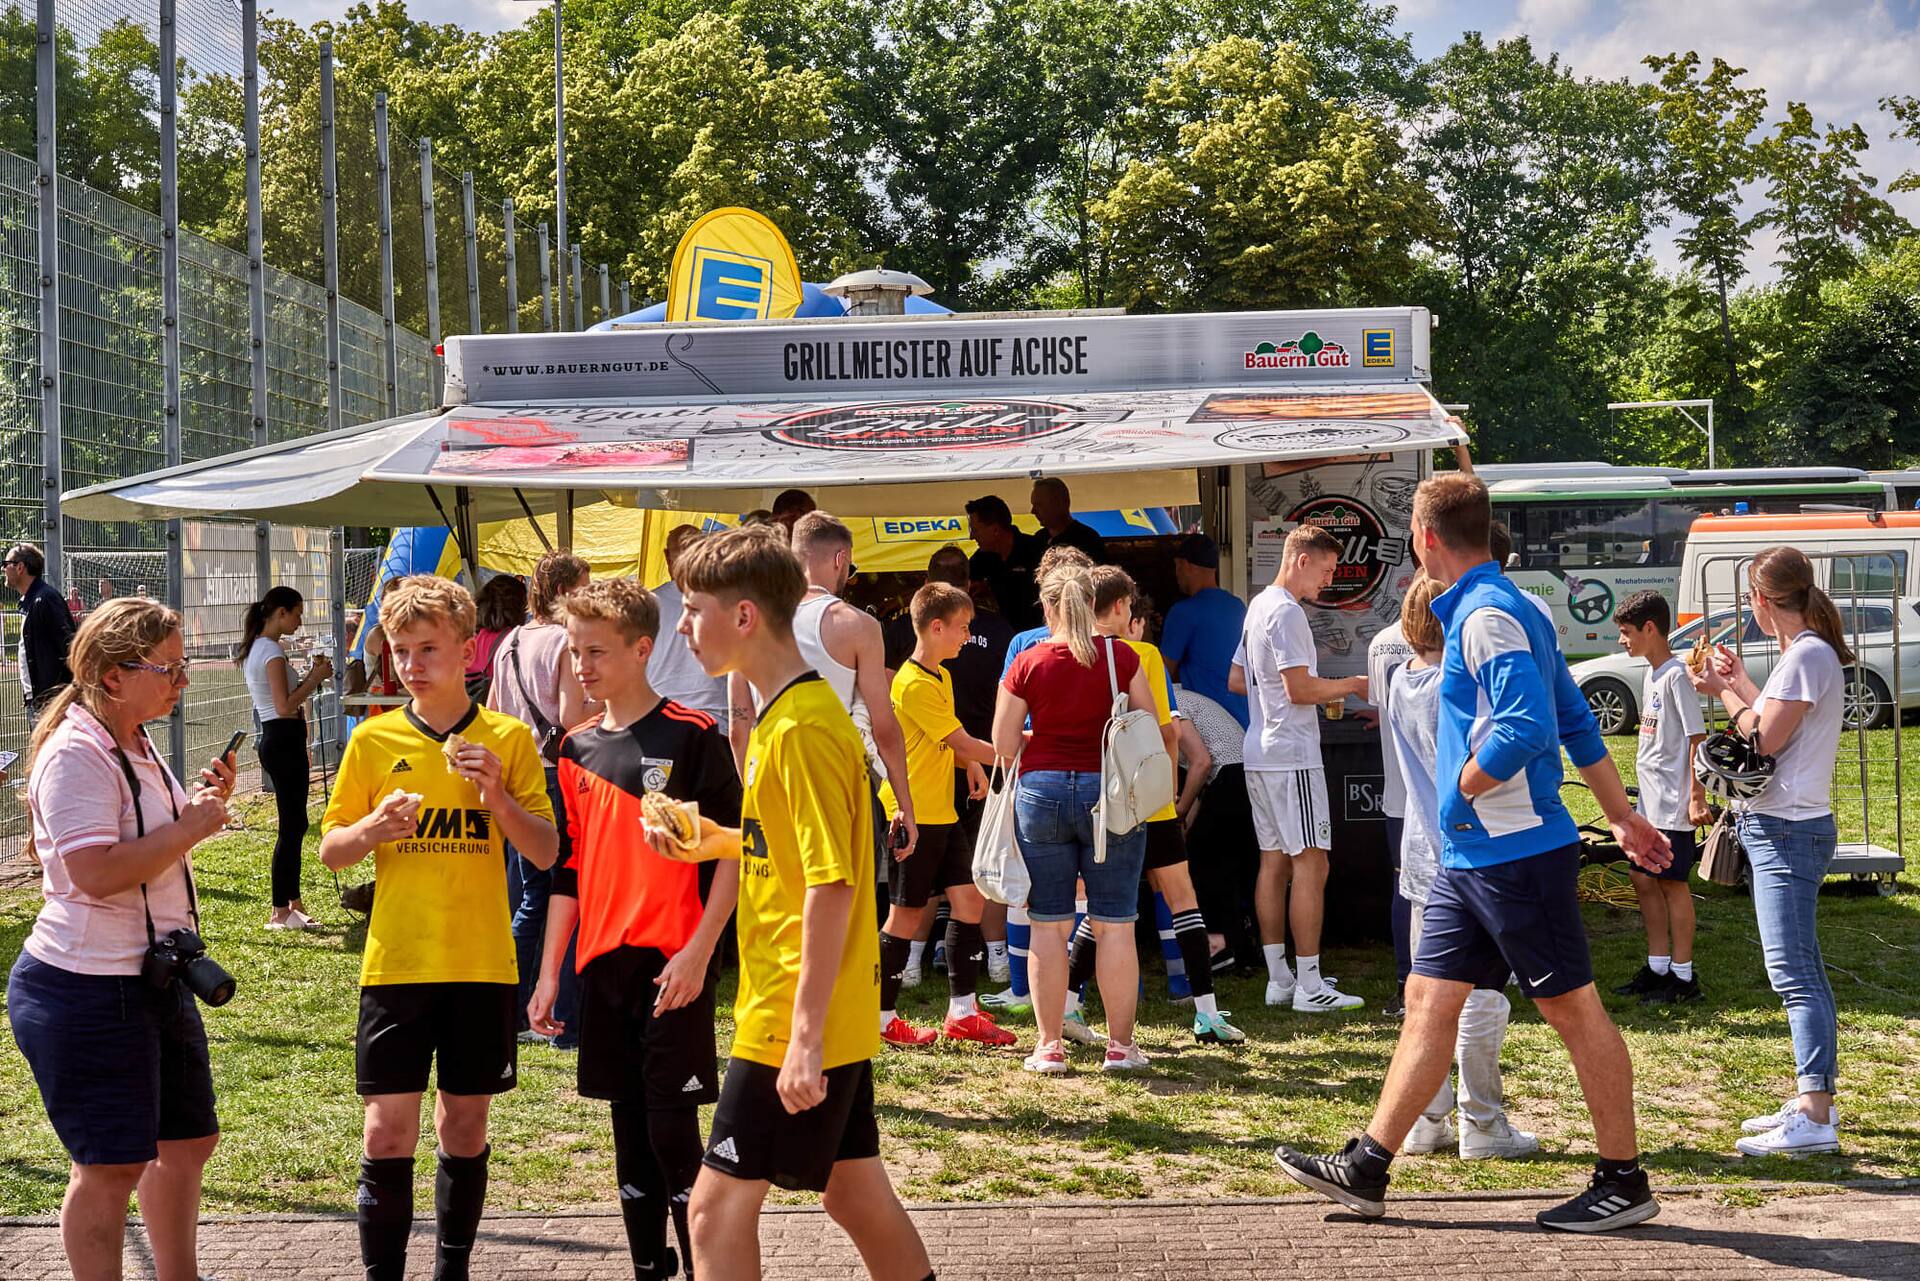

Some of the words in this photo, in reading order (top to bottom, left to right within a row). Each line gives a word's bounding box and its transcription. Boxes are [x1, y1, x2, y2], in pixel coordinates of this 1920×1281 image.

[784, 339, 951, 381] GRILLMEISTER
[959, 338, 1003, 378] AUF
[1011, 336, 1088, 376] ACHSE
[1245, 352, 1307, 369] Bauern
[884, 518, 962, 534] EDEKA
[403, 807, 462, 839] VM
[396, 842, 490, 854] VERSICHERUNG
